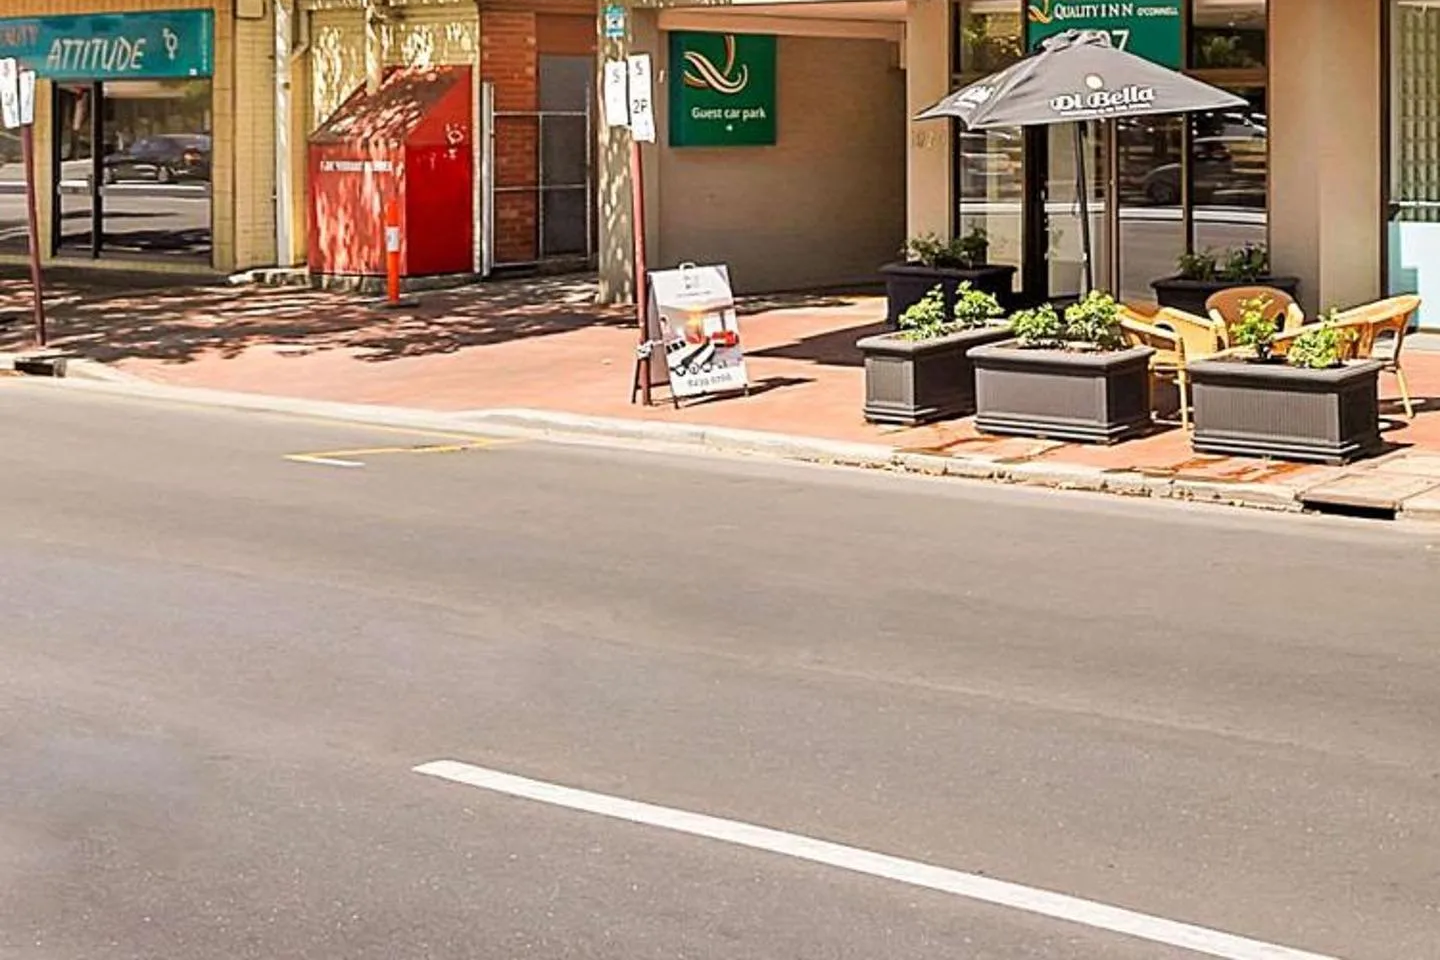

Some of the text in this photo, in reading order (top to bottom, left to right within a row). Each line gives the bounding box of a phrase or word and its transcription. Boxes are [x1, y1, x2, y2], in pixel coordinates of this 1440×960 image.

[1054, 3, 1099, 20] QUALITY
[1101, 3, 1134, 18] INN
[45, 36, 147, 71] ATTITUDE
[1087, 86, 1154, 107] Bella
[691, 107, 767, 122] Guest car park
